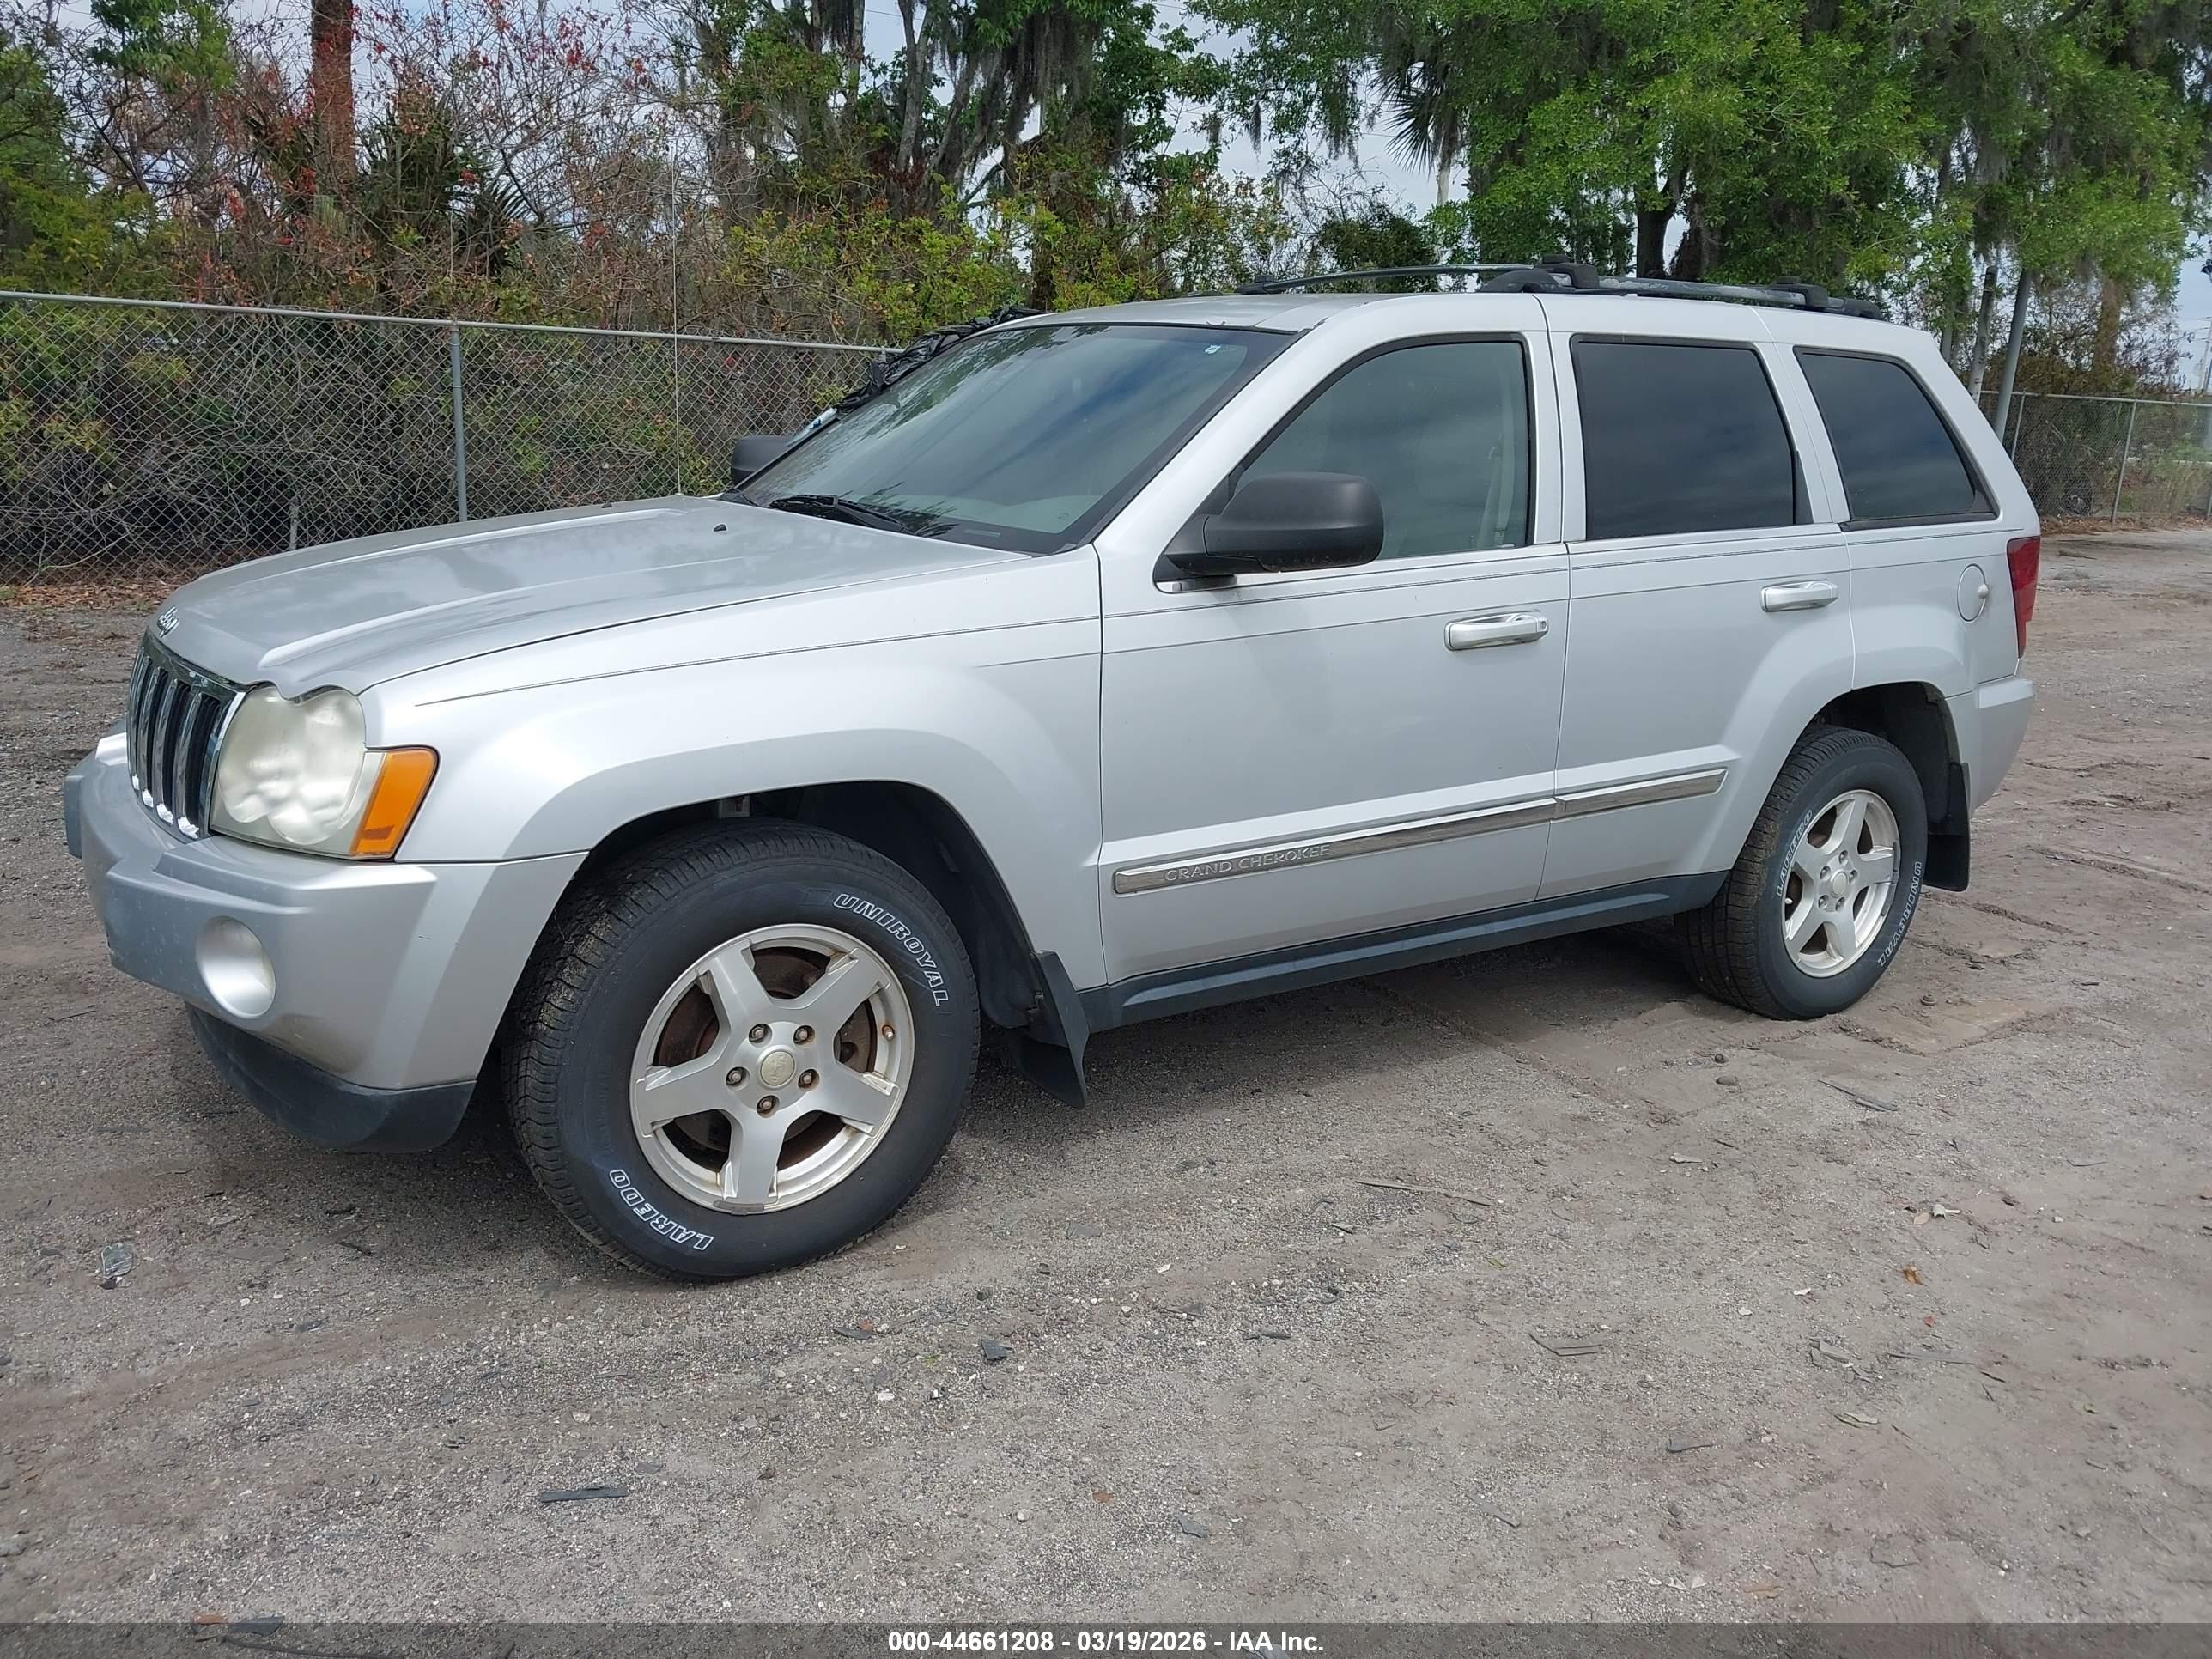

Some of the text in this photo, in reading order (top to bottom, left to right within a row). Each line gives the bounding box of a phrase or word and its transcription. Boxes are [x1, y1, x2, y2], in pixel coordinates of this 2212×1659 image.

[1164, 844, 1331, 882] GRAND CHEROKEE
[833, 893, 949, 1006] UNIROYAL
[1877, 861, 1922, 967] UNIROYAL
[609, 1169, 714, 1251] LAREDO
